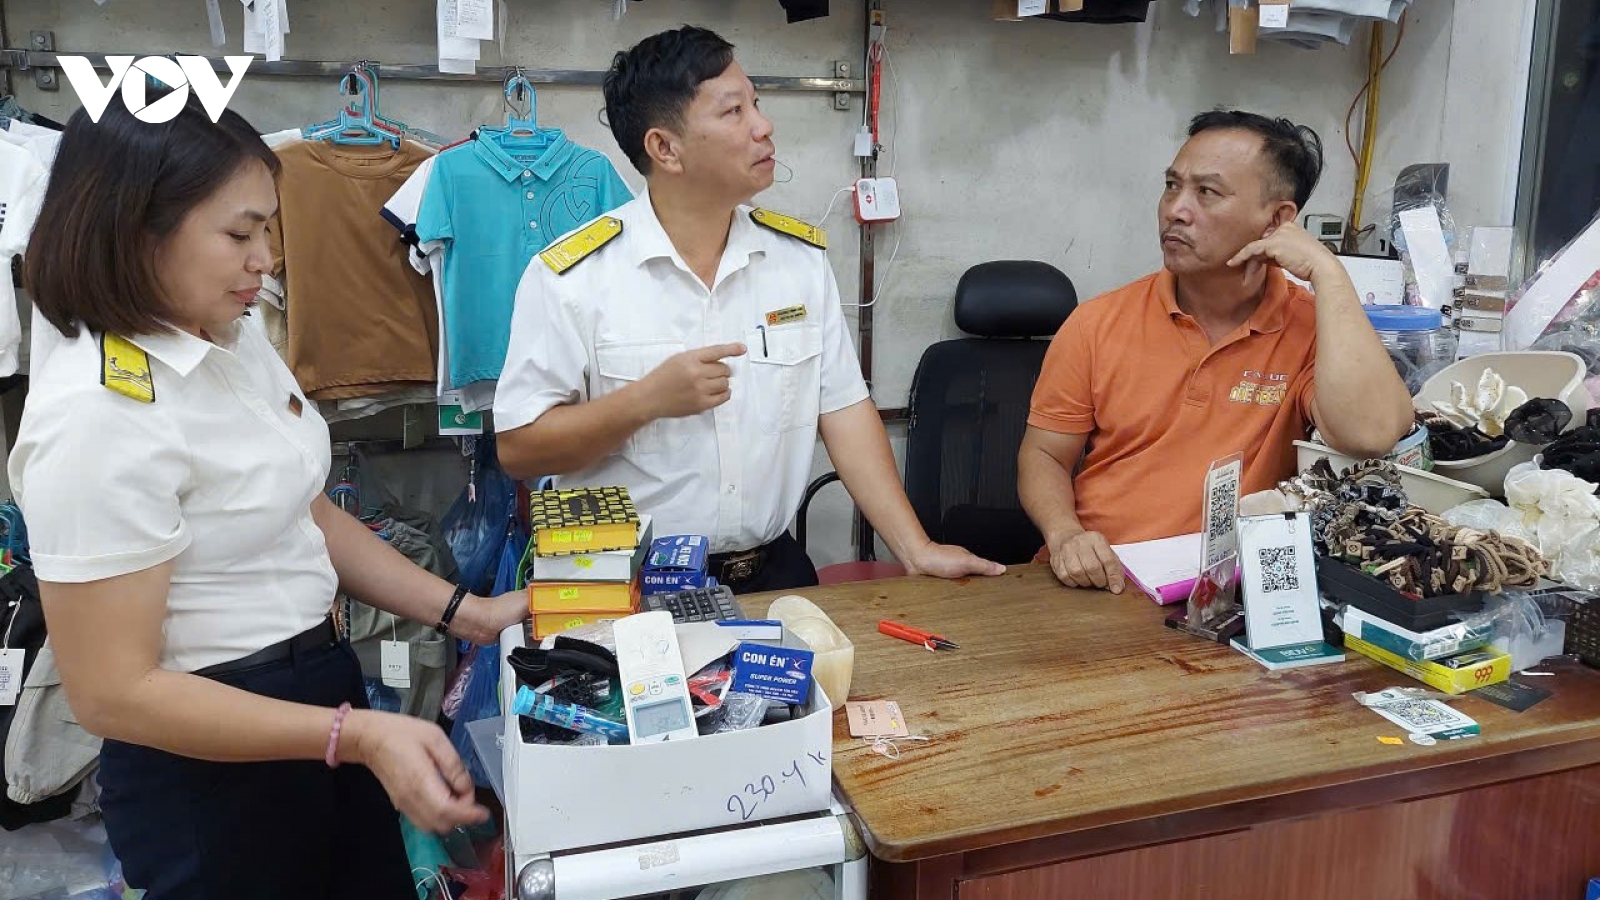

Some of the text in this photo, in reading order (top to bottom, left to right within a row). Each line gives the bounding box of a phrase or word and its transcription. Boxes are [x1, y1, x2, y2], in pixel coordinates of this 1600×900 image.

[644, 576, 664, 585] CON
[742, 651, 767, 665] CON
[750, 673, 797, 685] SUPER POWER
[1474, 664, 1494, 685] 999
